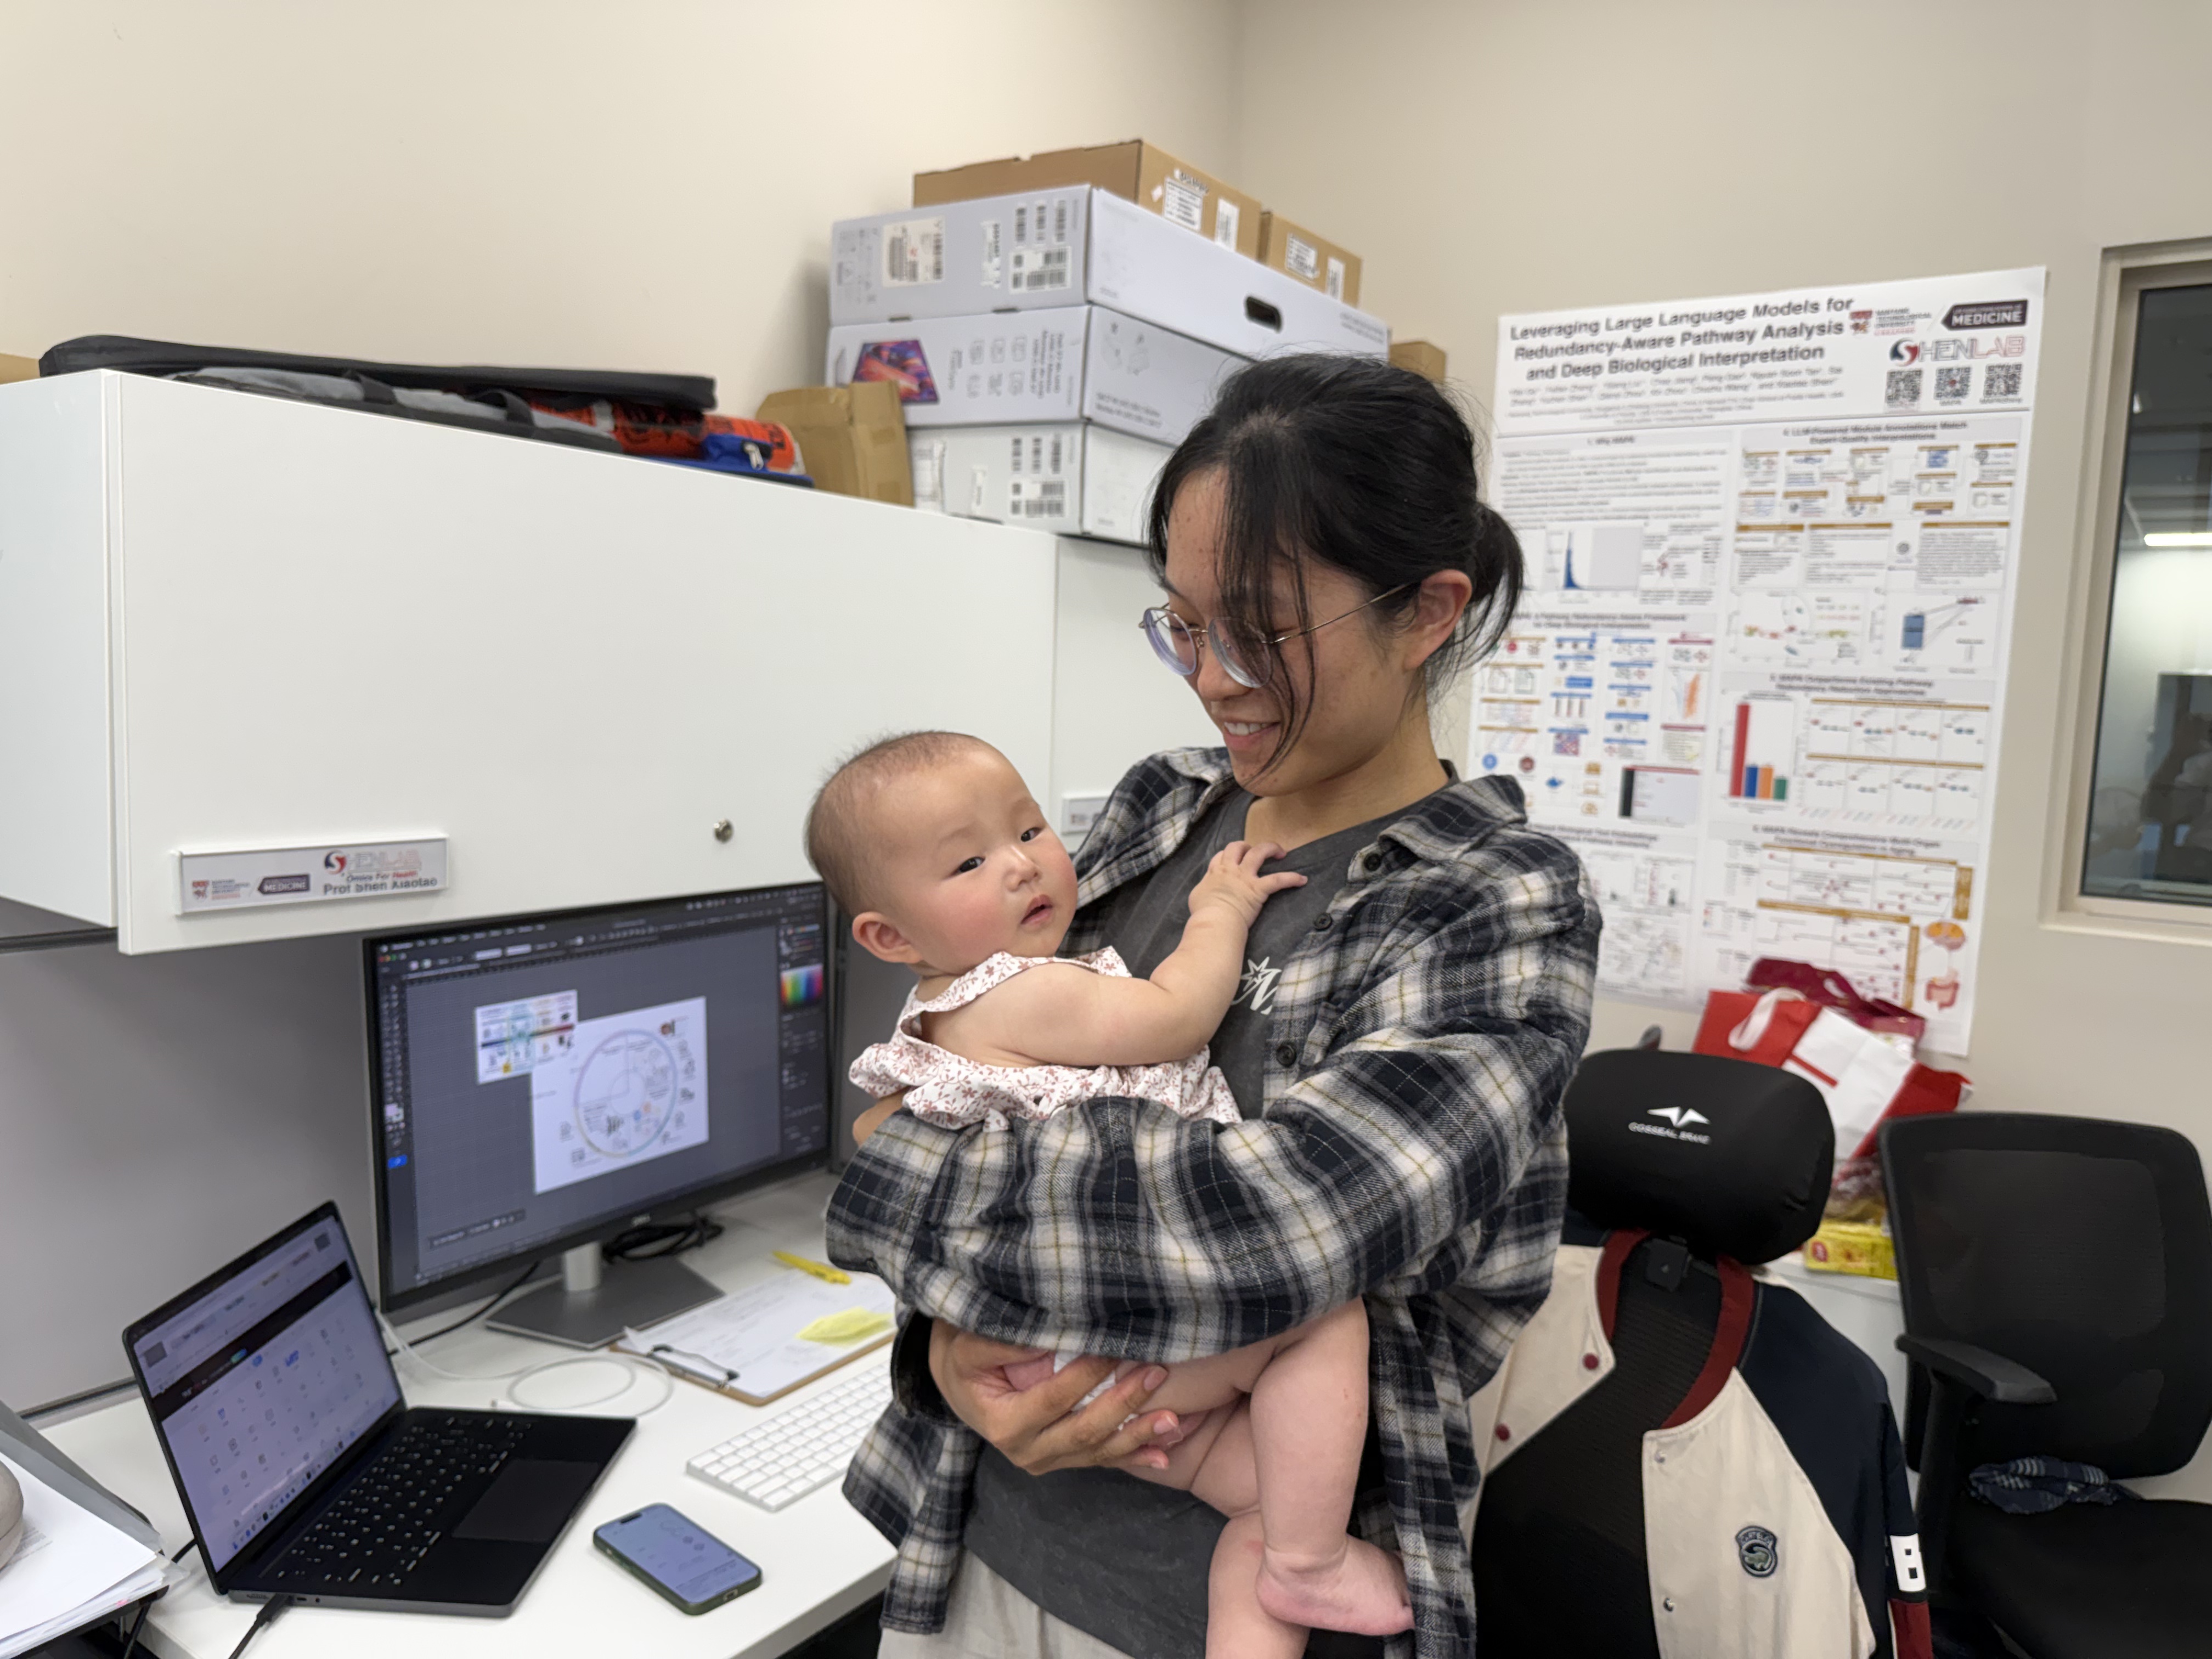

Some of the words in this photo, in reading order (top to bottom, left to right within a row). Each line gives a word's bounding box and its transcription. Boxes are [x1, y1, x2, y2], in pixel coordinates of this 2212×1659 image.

[1510, 320, 1600, 340] Leveraging
[1605, 315, 1653, 332] Large
[1658, 308, 1747, 328] Language
[1752, 300, 1820, 318] Models
[1826, 297, 1854, 312] for
[1951, 311, 2023, 327] MEDICINE
[1514, 335, 1675, 361] Redundancy-Aware
[1680, 329, 1757, 346] Pathway
[1762, 320, 1844, 341] Analysis
[1526, 365, 1556, 381] and
[1561, 362, 1604, 379] Deep
[1607, 354, 1695, 374] Biological
[1699, 346, 1825, 368] Interpretation
